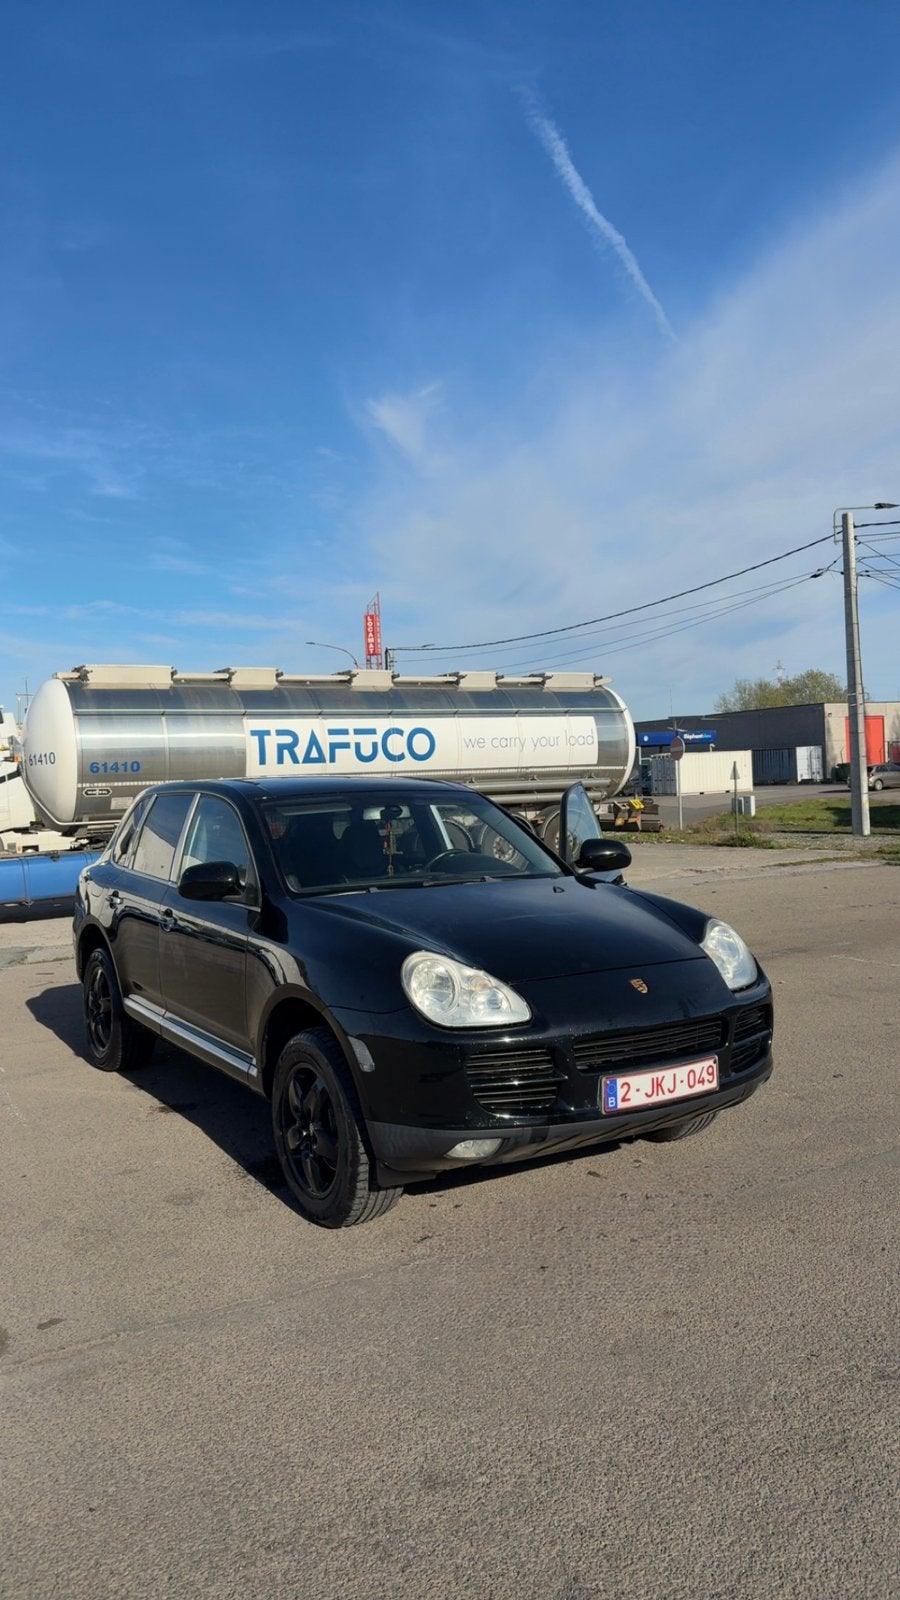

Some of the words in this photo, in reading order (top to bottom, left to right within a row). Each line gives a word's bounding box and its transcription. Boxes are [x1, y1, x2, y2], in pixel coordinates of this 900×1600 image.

[367, 615, 375, 654] LOCAMAT
[250, 727, 436, 766] TRAFUCO
[463, 737, 487, 749] we
[490, 736, 527, 753] carry
[531, 735, 561, 752] your
[564, 728, 595, 747] load
[28, 751, 56, 767] 61410
[89, 760, 141, 774] 61410
[620, 1064, 716, 1103] 2-JKJ-049
[608, 1096, 616, 1108] B
